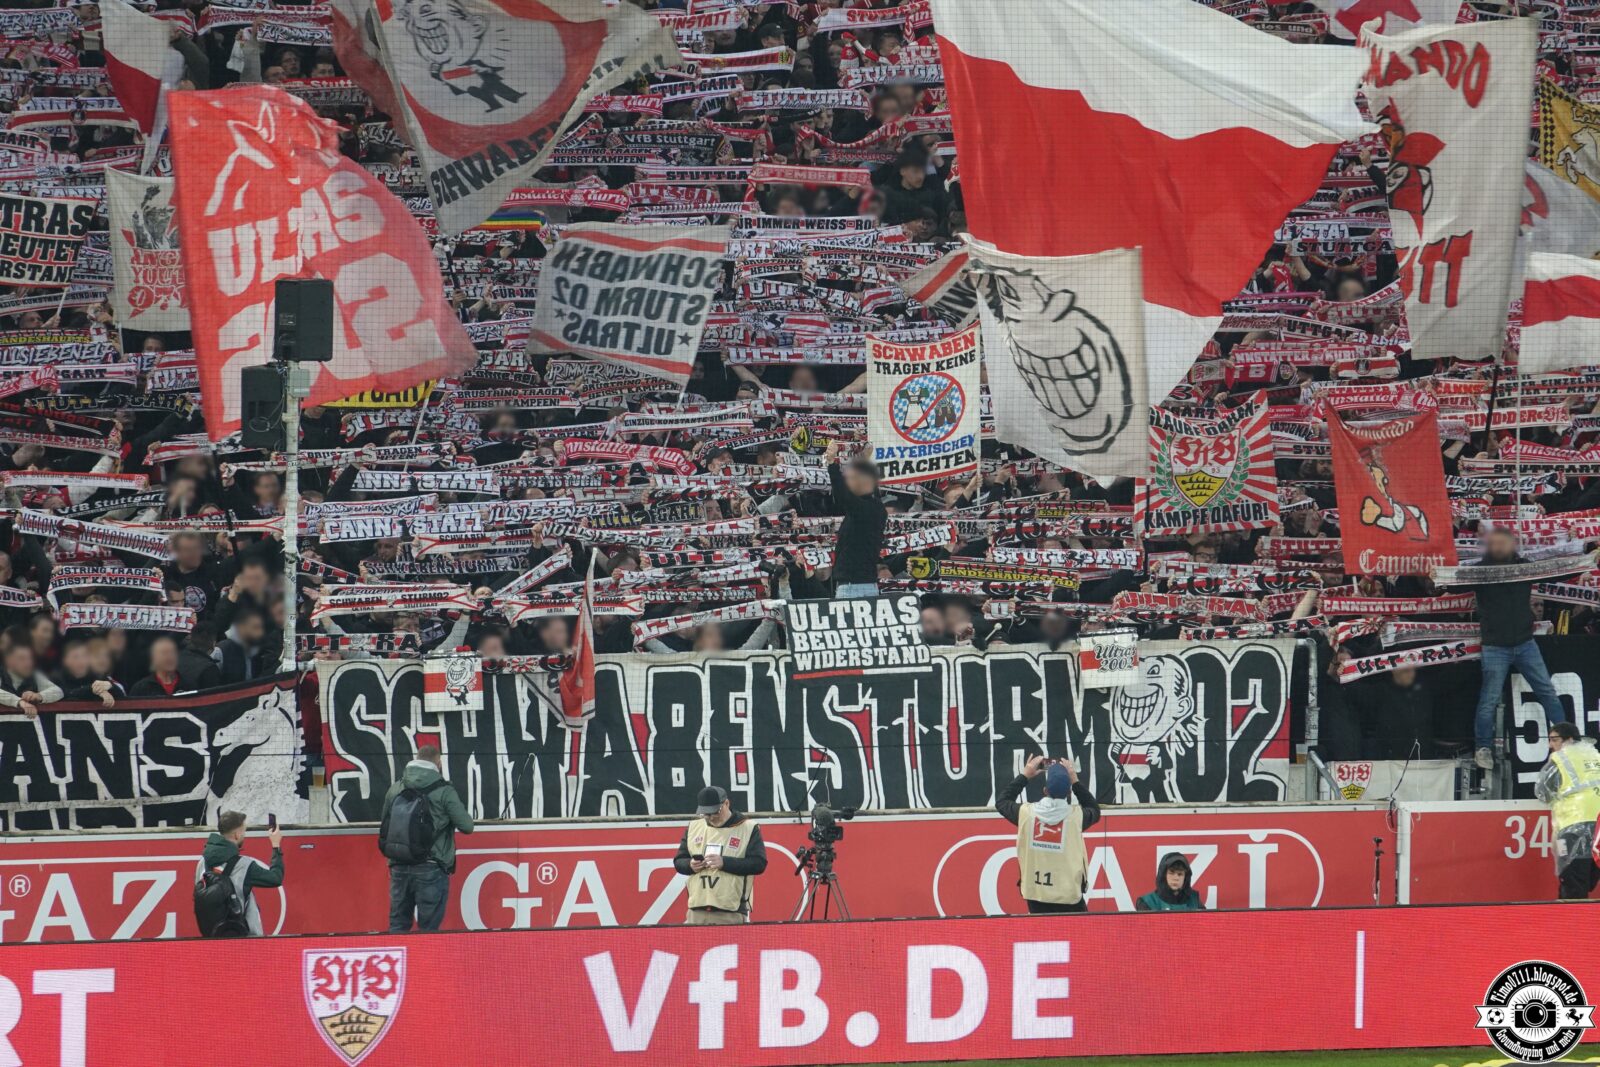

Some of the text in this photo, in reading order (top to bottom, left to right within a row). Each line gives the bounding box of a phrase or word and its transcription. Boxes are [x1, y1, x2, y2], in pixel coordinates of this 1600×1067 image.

[656, 135, 716, 147] Stuttgart
[666, 170, 748, 181] STUTTGA
[0, 198, 94, 237] TRAS
[805, 218, 847, 231] WEISS
[0, 233, 80, 262] EUTET
[1296, 240, 1394, 253] STUTTGA
[1287, 319, 1358, 343] UTTGA
[872, 331, 977, 361] SCHWABEN
[873, 350, 977, 375] TRAGEN KEINE
[1232, 351, 1310, 362] NNSTATTER
[875, 433, 977, 459] BAYERISCHEN
[1292, 444, 1332, 455] STUT
[876, 449, 977, 478] TRACHTEN
[1144, 502, 1269, 529] KÄMPFE DAFÜR!
[503, 529, 533, 538] STUR
[1575, 526, 1600, 540] CAN
[1270, 540, 1339, 550] STUTT
[53, 565, 107, 579] USTRING
[51, 577, 89, 588] HEISST
[329, 592, 450, 609] SCHWABEN STURM02
[1537, 583, 1600, 602] STADIO
[788, 595, 921, 631] ULTRAS
[1430, 597, 1476, 612] KURV
[67, 604, 194, 629] STUTTGART
[792, 624, 921, 653] BEDEUTET
[792, 644, 932, 672] WIDERSTAND
[1094, 643, 1137, 660] Ultras
[326, 643, 1288, 823] SCHWABENSTURM 02
[0, 711, 211, 802] ANS
[699, 875, 720, 889] TV
[1034, 871, 1054, 887] 11
[0, 869, 178, 943] AZ
[582, 941, 1075, 1053] VfB.DE
